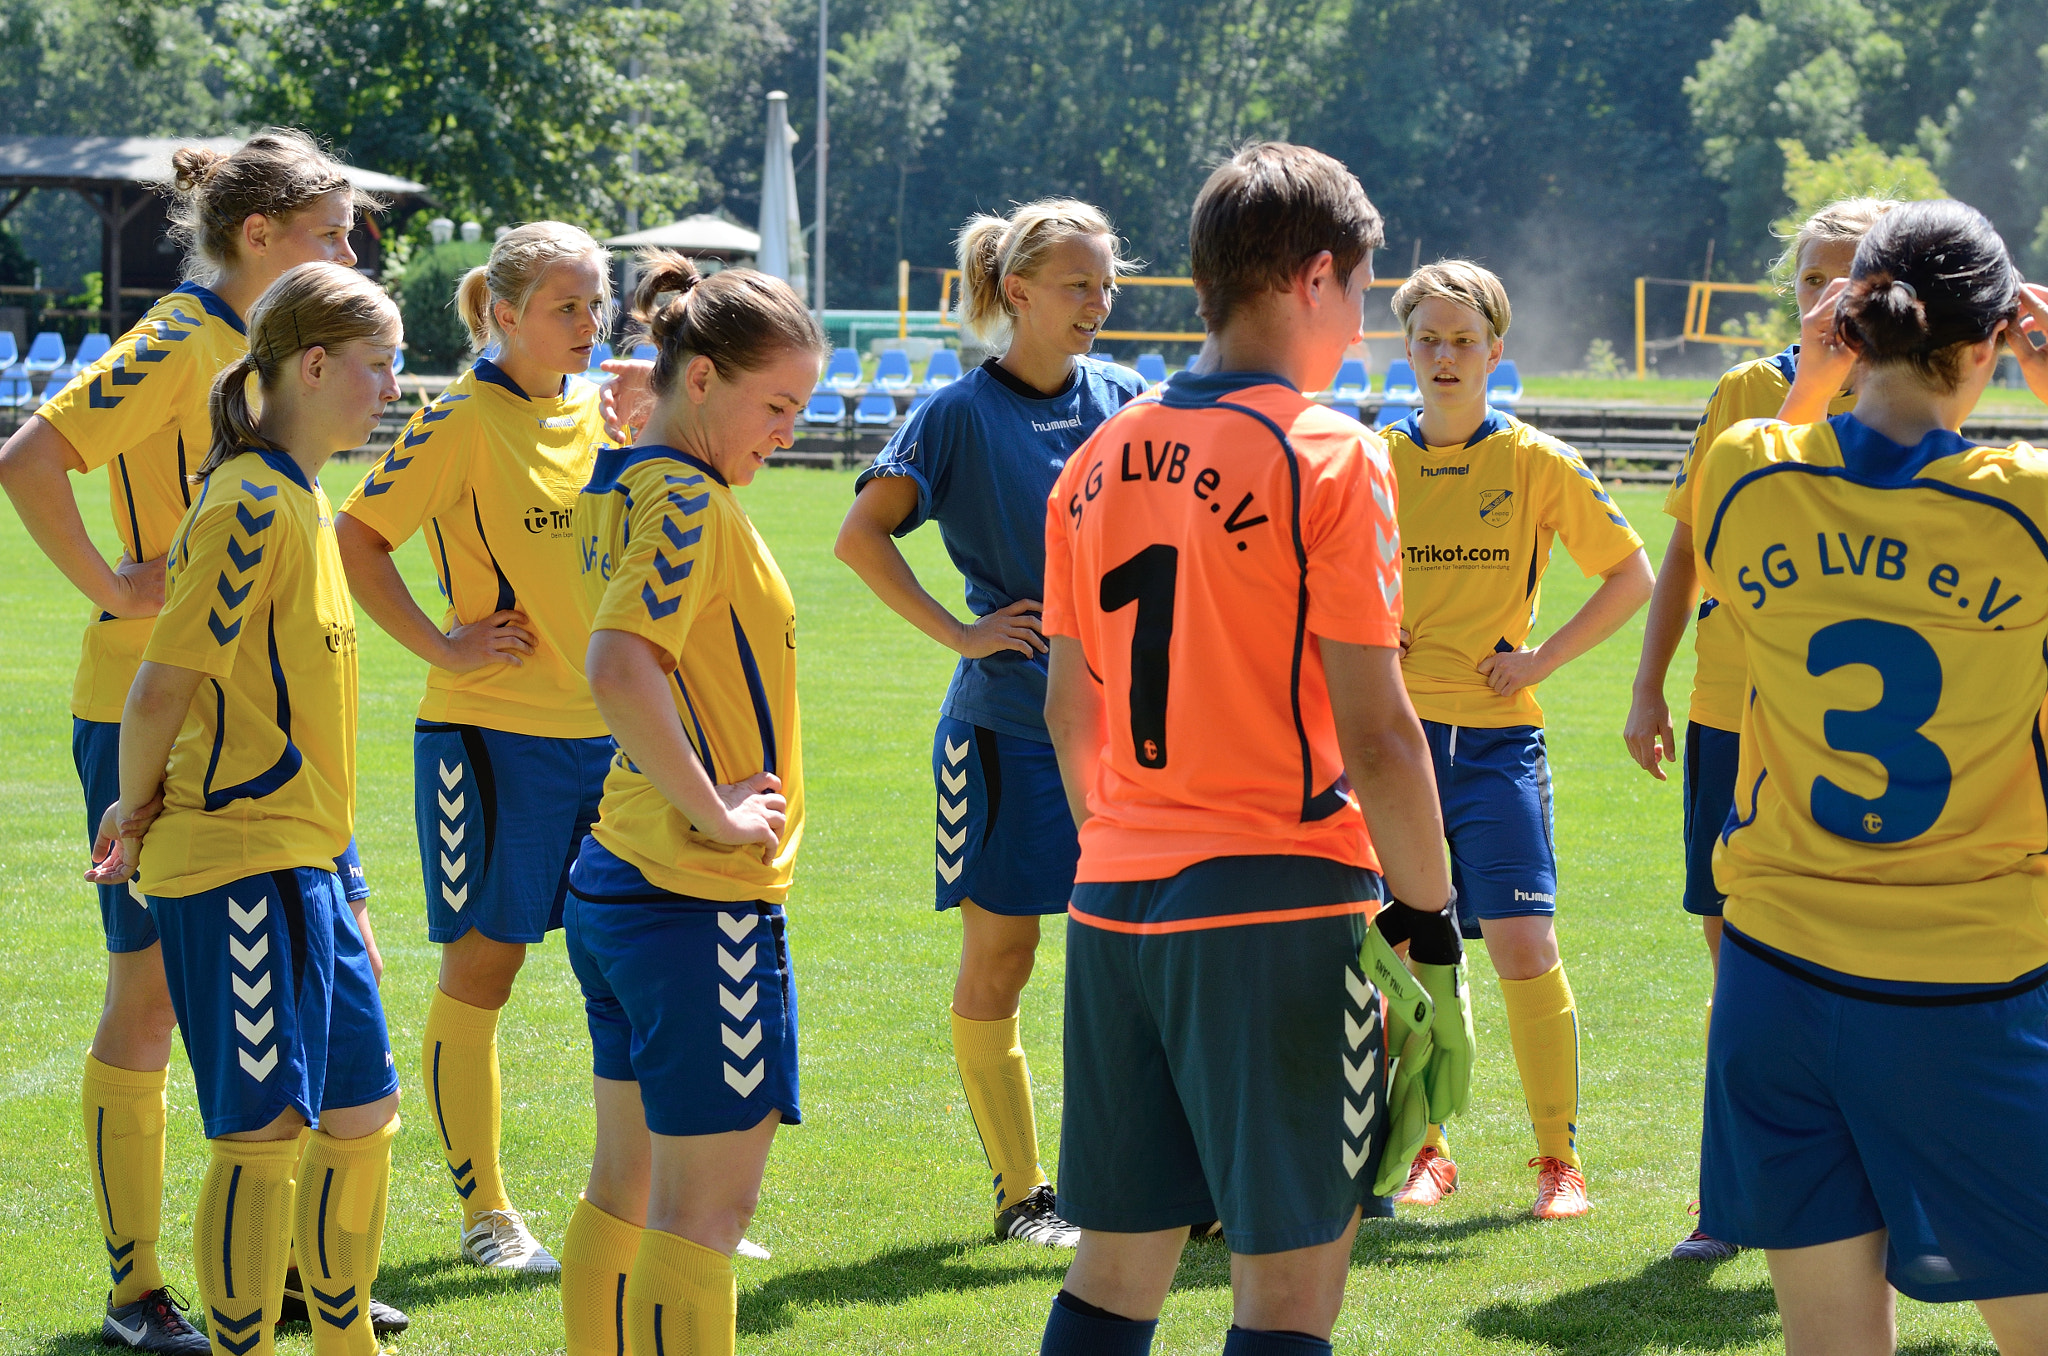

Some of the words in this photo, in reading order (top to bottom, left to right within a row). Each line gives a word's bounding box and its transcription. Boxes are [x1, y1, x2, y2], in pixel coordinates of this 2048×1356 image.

[1031, 414, 1082, 432] hummel
[1069, 460, 1103, 531] SG
[1121, 440, 1190, 484] LVB
[1193, 467, 1269, 552] e.V.
[1420, 464, 1470, 477] hummel
[1406, 544, 1510, 563] Trikot.com
[1738, 543, 1799, 609] SG
[1817, 532, 1908, 581] LVB
[1100, 544, 1178, 769] 1
[1806, 618, 1952, 844] 3
